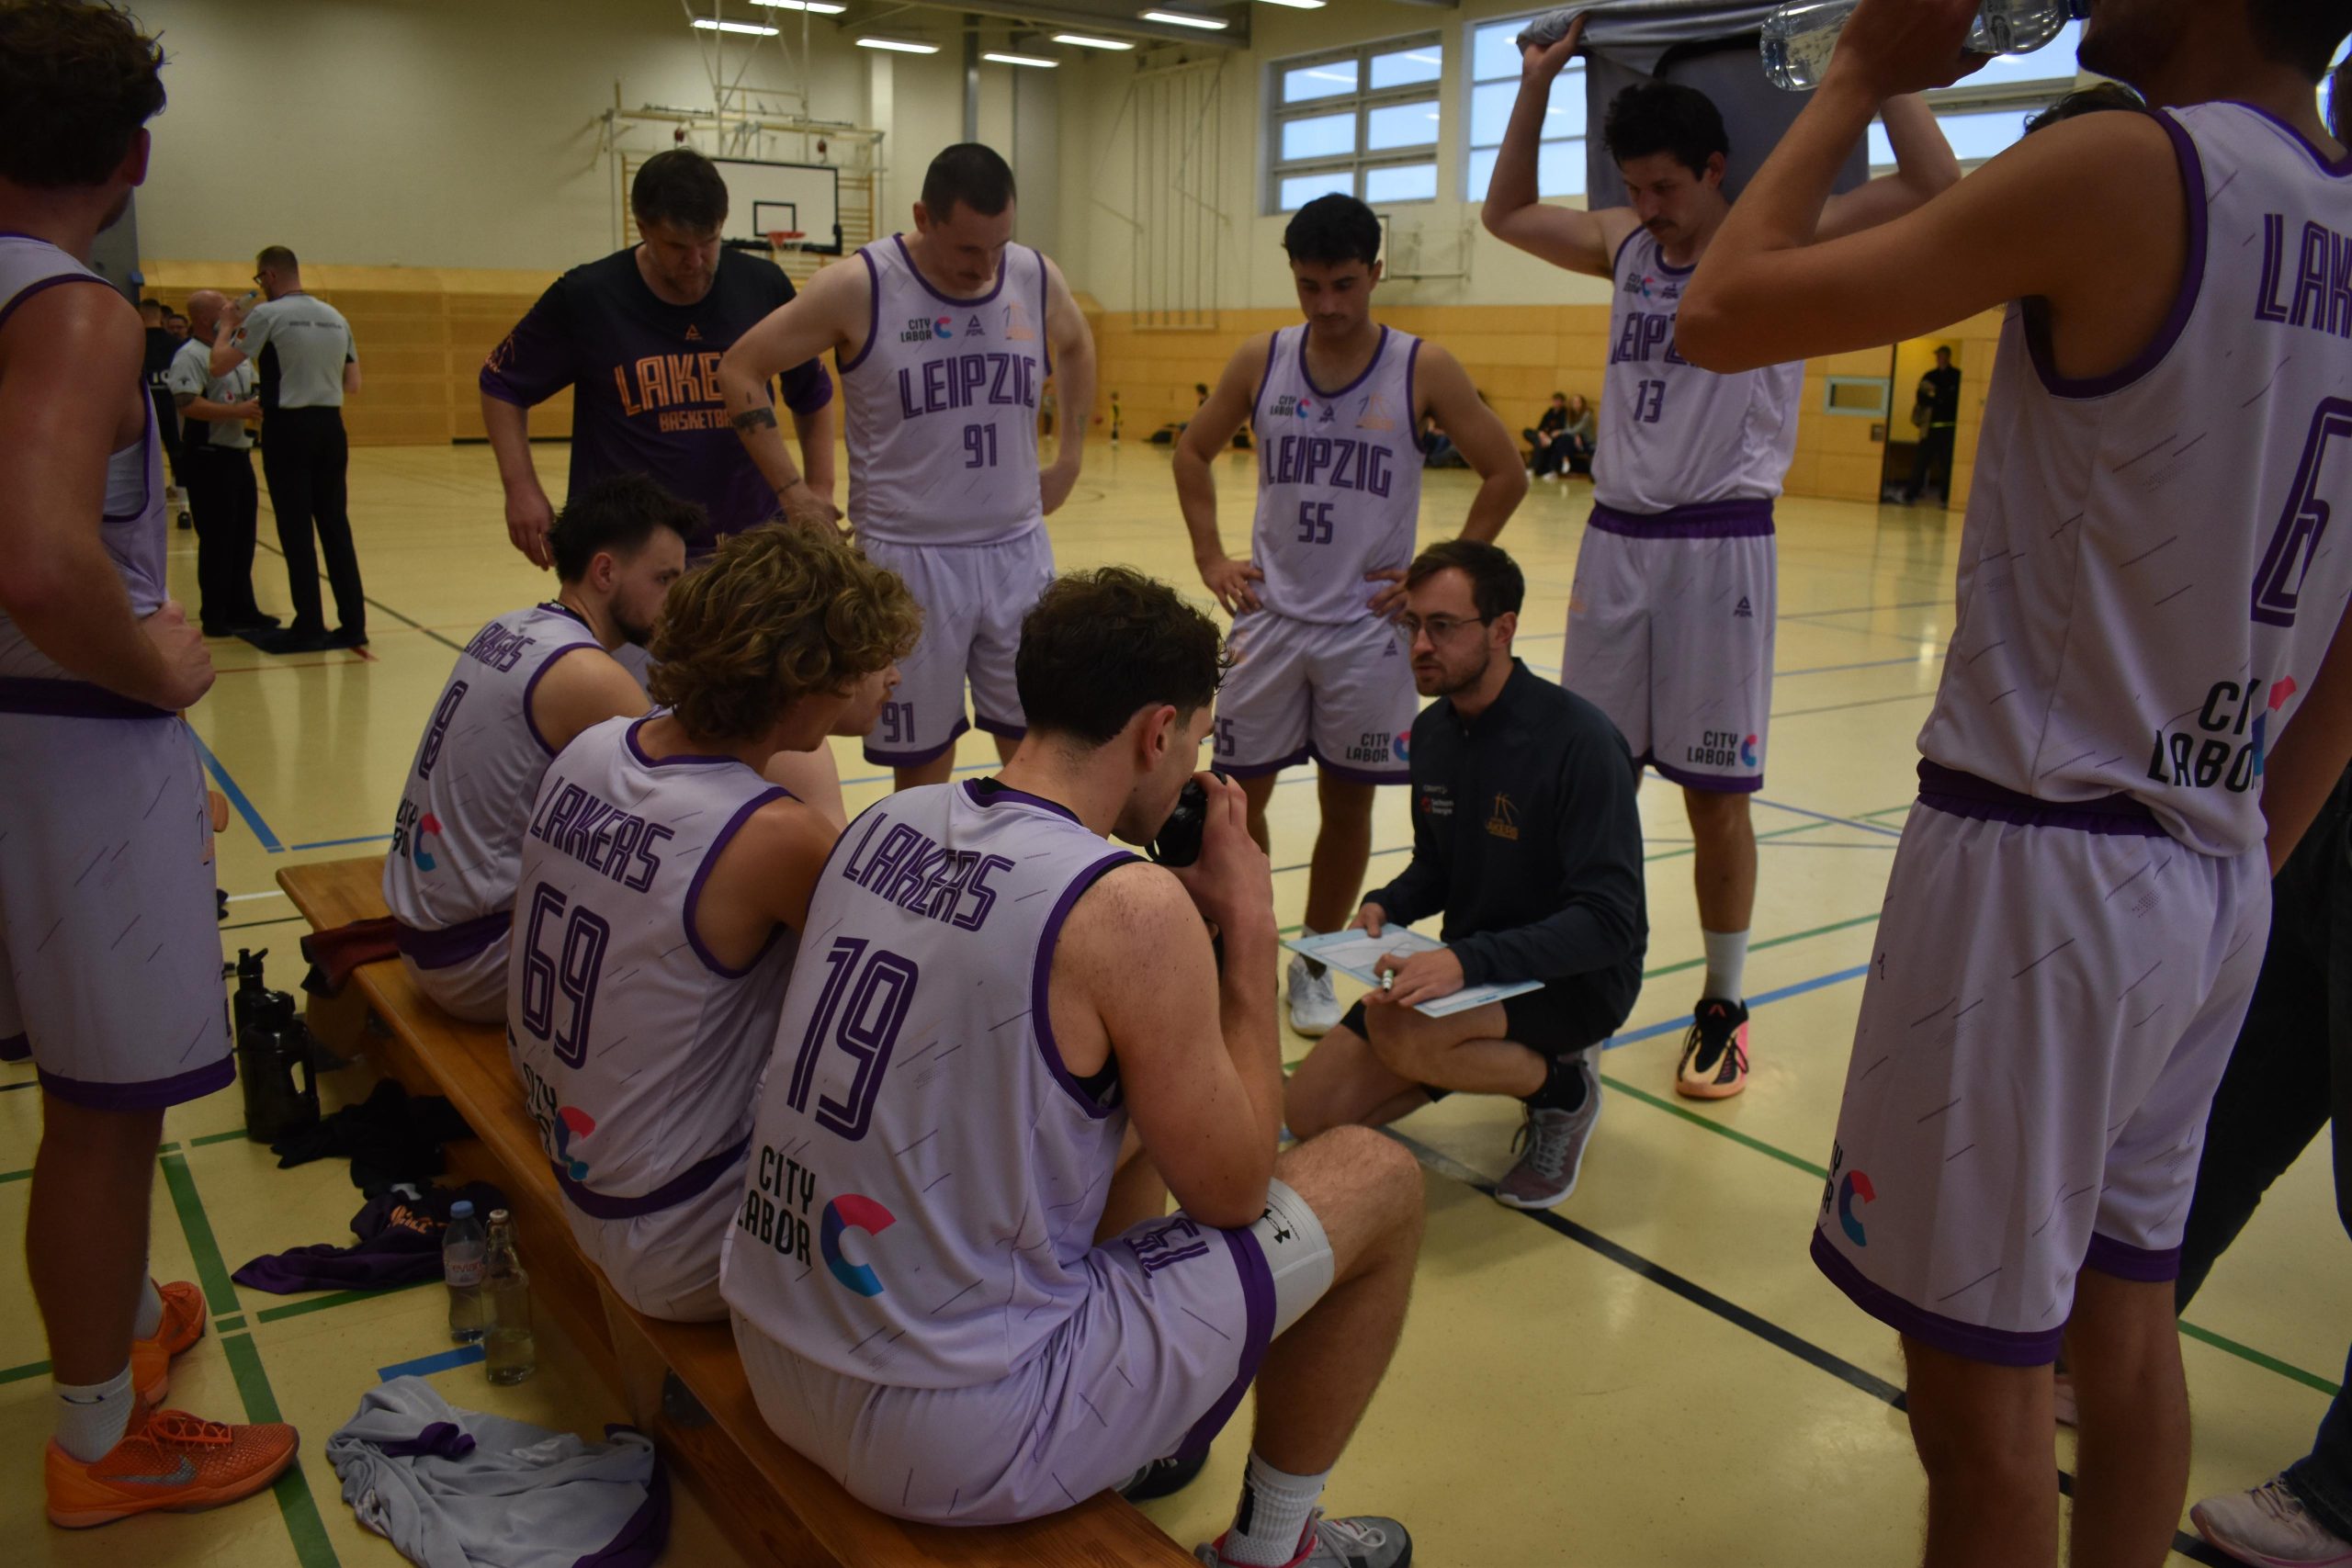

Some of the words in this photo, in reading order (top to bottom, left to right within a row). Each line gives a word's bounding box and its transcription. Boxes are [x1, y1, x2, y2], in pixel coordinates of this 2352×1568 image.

[900, 330, 933, 343] LABOR
[909, 318, 931, 330] CITY
[1611, 311, 1695, 367] EIPZ
[614, 352, 724, 417] LAKE
[1634, 379, 1666, 423] 13
[964, 423, 997, 468] 91
[1266, 435, 1393, 499] LEIPZIG
[1297, 501, 1334, 545] 55
[464, 622, 537, 672] AKERS
[882, 701, 915, 743] 91
[1361, 732, 1391, 747] CITY
[1702, 730, 1738, 749] CITY
[1346, 747, 1389, 763] LABOR
[1687, 746, 1736, 767] LABOR
[2147, 729, 2255, 793] LABO
[529, 776, 674, 894] LAKERS
[842, 813, 1015, 932] LAKERS
[522, 881, 610, 1069] 69
[786, 936, 919, 1142] 19
[760, 1145, 816, 1215] CITY
